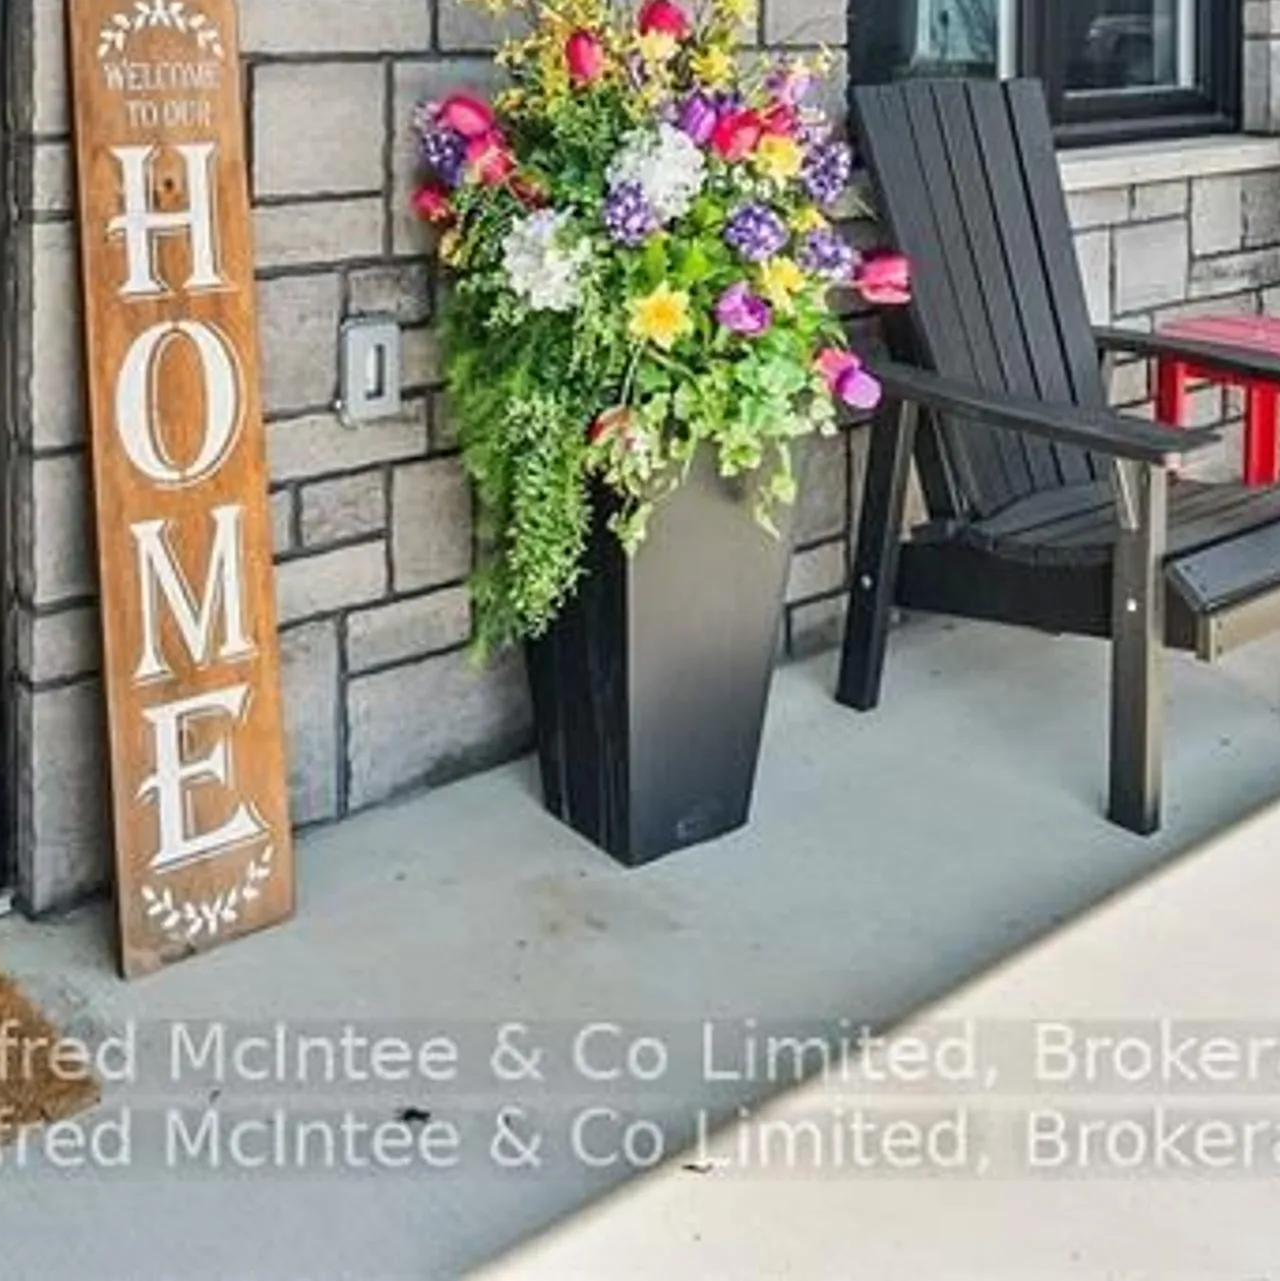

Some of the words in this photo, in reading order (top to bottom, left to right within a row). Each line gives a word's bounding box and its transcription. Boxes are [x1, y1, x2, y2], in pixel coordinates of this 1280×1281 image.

[102, 59, 221, 91] WELCOME
[124, 99, 158, 128] TO
[162, 99, 213, 128] OUR
[107, 141, 270, 873] HOME
